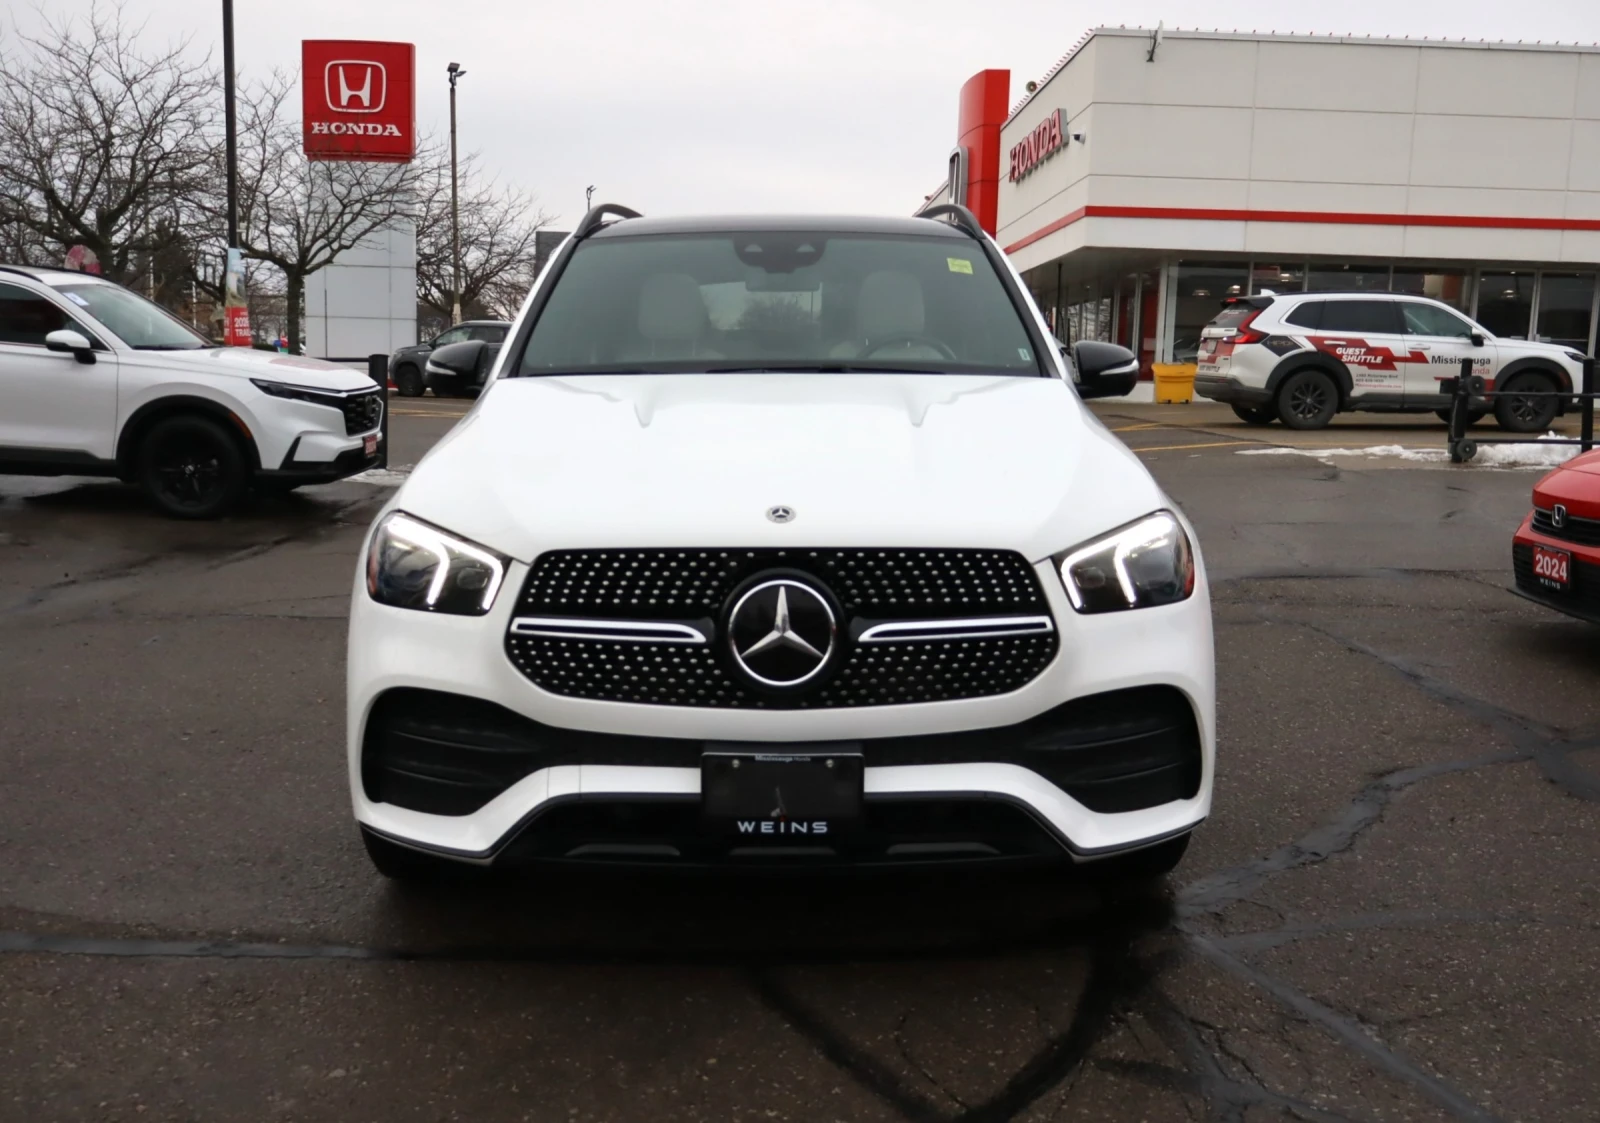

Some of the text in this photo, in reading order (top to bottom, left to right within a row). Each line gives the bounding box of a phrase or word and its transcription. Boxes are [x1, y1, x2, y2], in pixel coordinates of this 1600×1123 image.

[311, 121, 402, 137] HONDA
[1009, 108, 1066, 183] HONDA
[1335, 347, 1367, 355] GUEST
[1341, 355, 1384, 364] SHUTTLE
[1431, 355, 1491, 366] Missisuga
[1535, 553, 1567, 581] 2024
[1540, 577, 1561, 589] WEINS
[737, 821, 829, 834] WEINS
